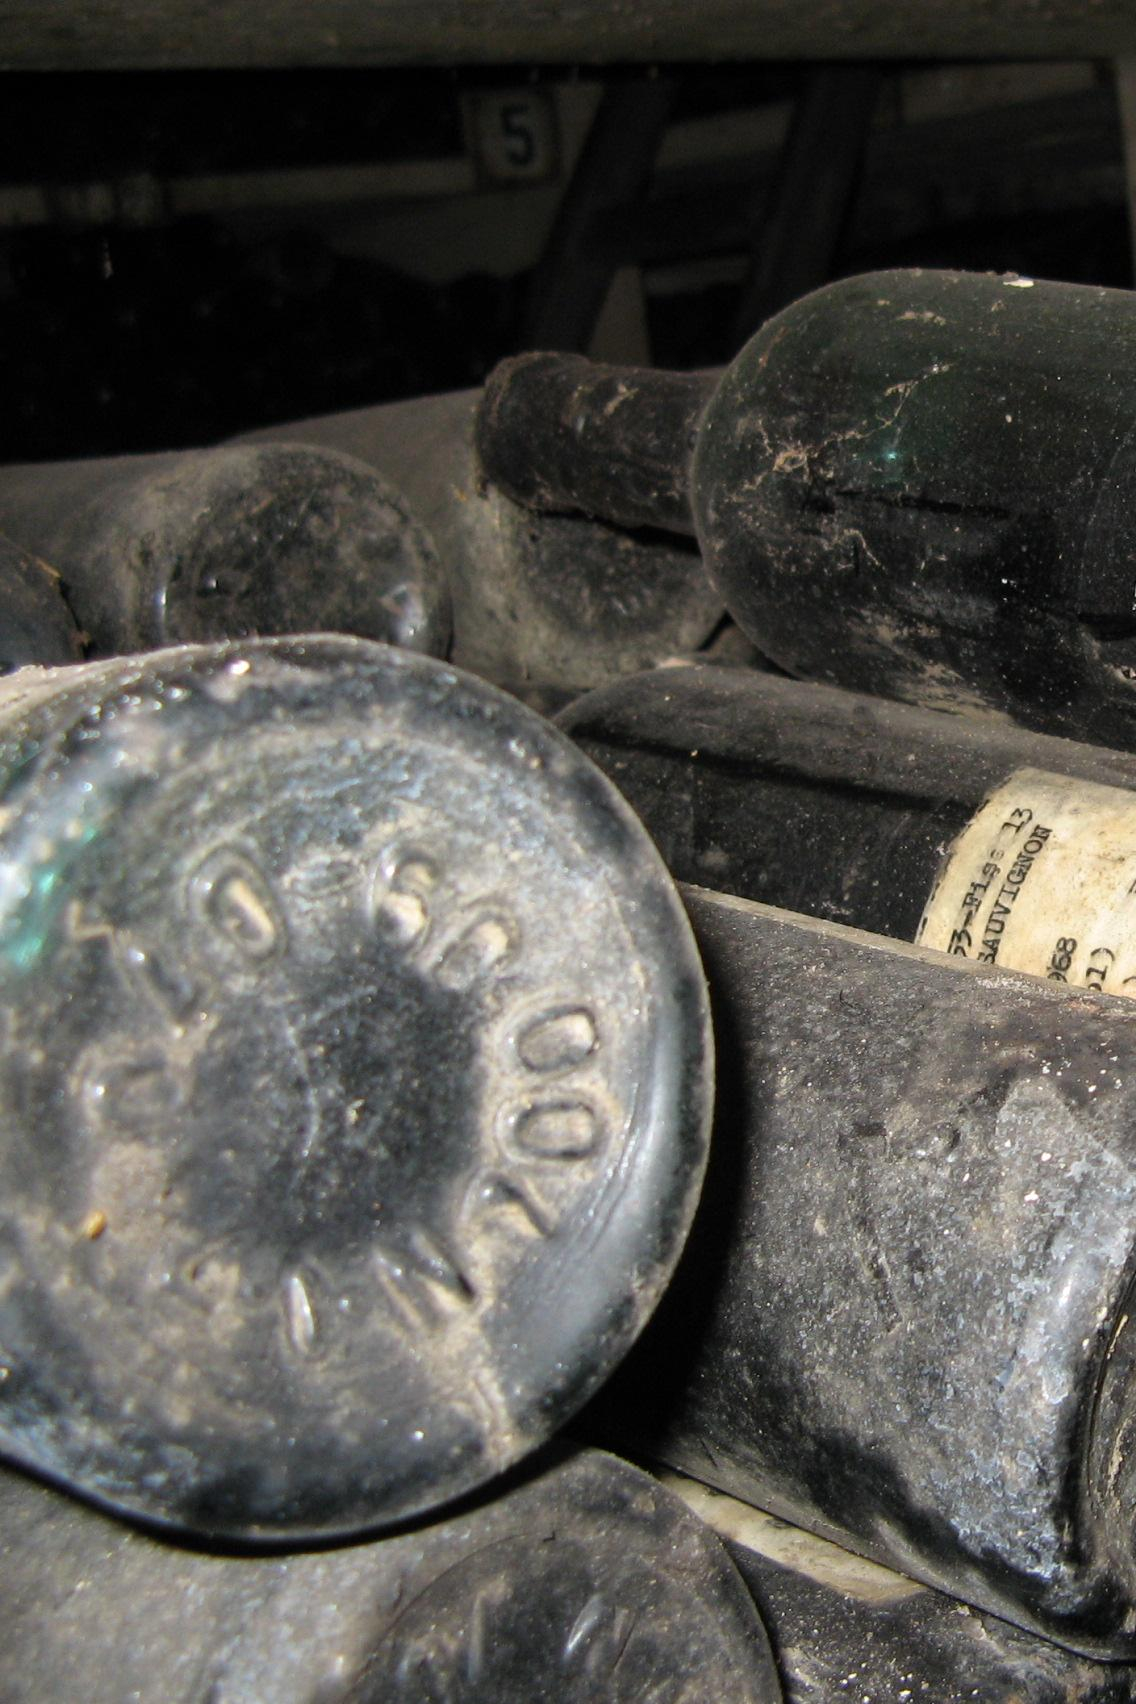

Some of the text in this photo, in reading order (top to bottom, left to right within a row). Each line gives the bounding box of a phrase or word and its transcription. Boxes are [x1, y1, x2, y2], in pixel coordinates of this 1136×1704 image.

[501, 103, 534, 166] 5
[1001, 807, 1033, 834] 13
[977, 823, 1053, 965] SAUVIGNON
